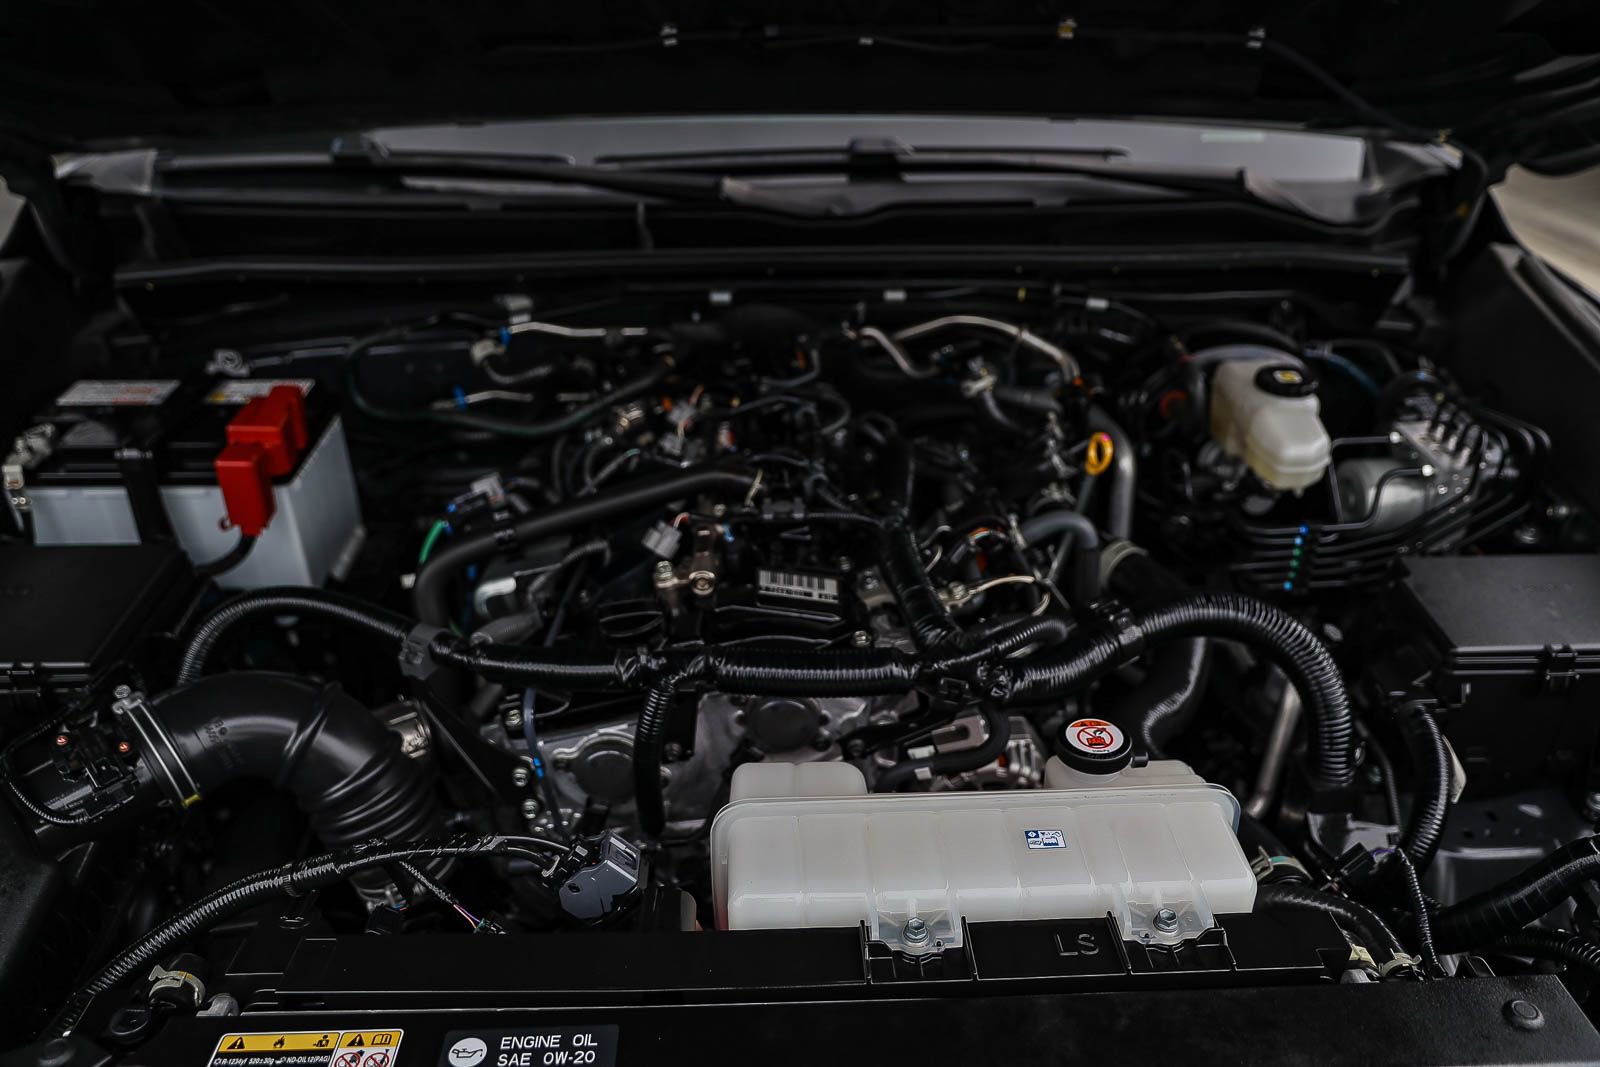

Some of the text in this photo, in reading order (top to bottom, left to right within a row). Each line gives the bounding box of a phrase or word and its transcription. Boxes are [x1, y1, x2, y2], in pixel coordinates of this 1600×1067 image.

[1054, 934, 1099, 957] LS
[500, 1033, 598, 1049] ENGINE OIL
[496, 1050, 596, 1067] SAE 0W-20
